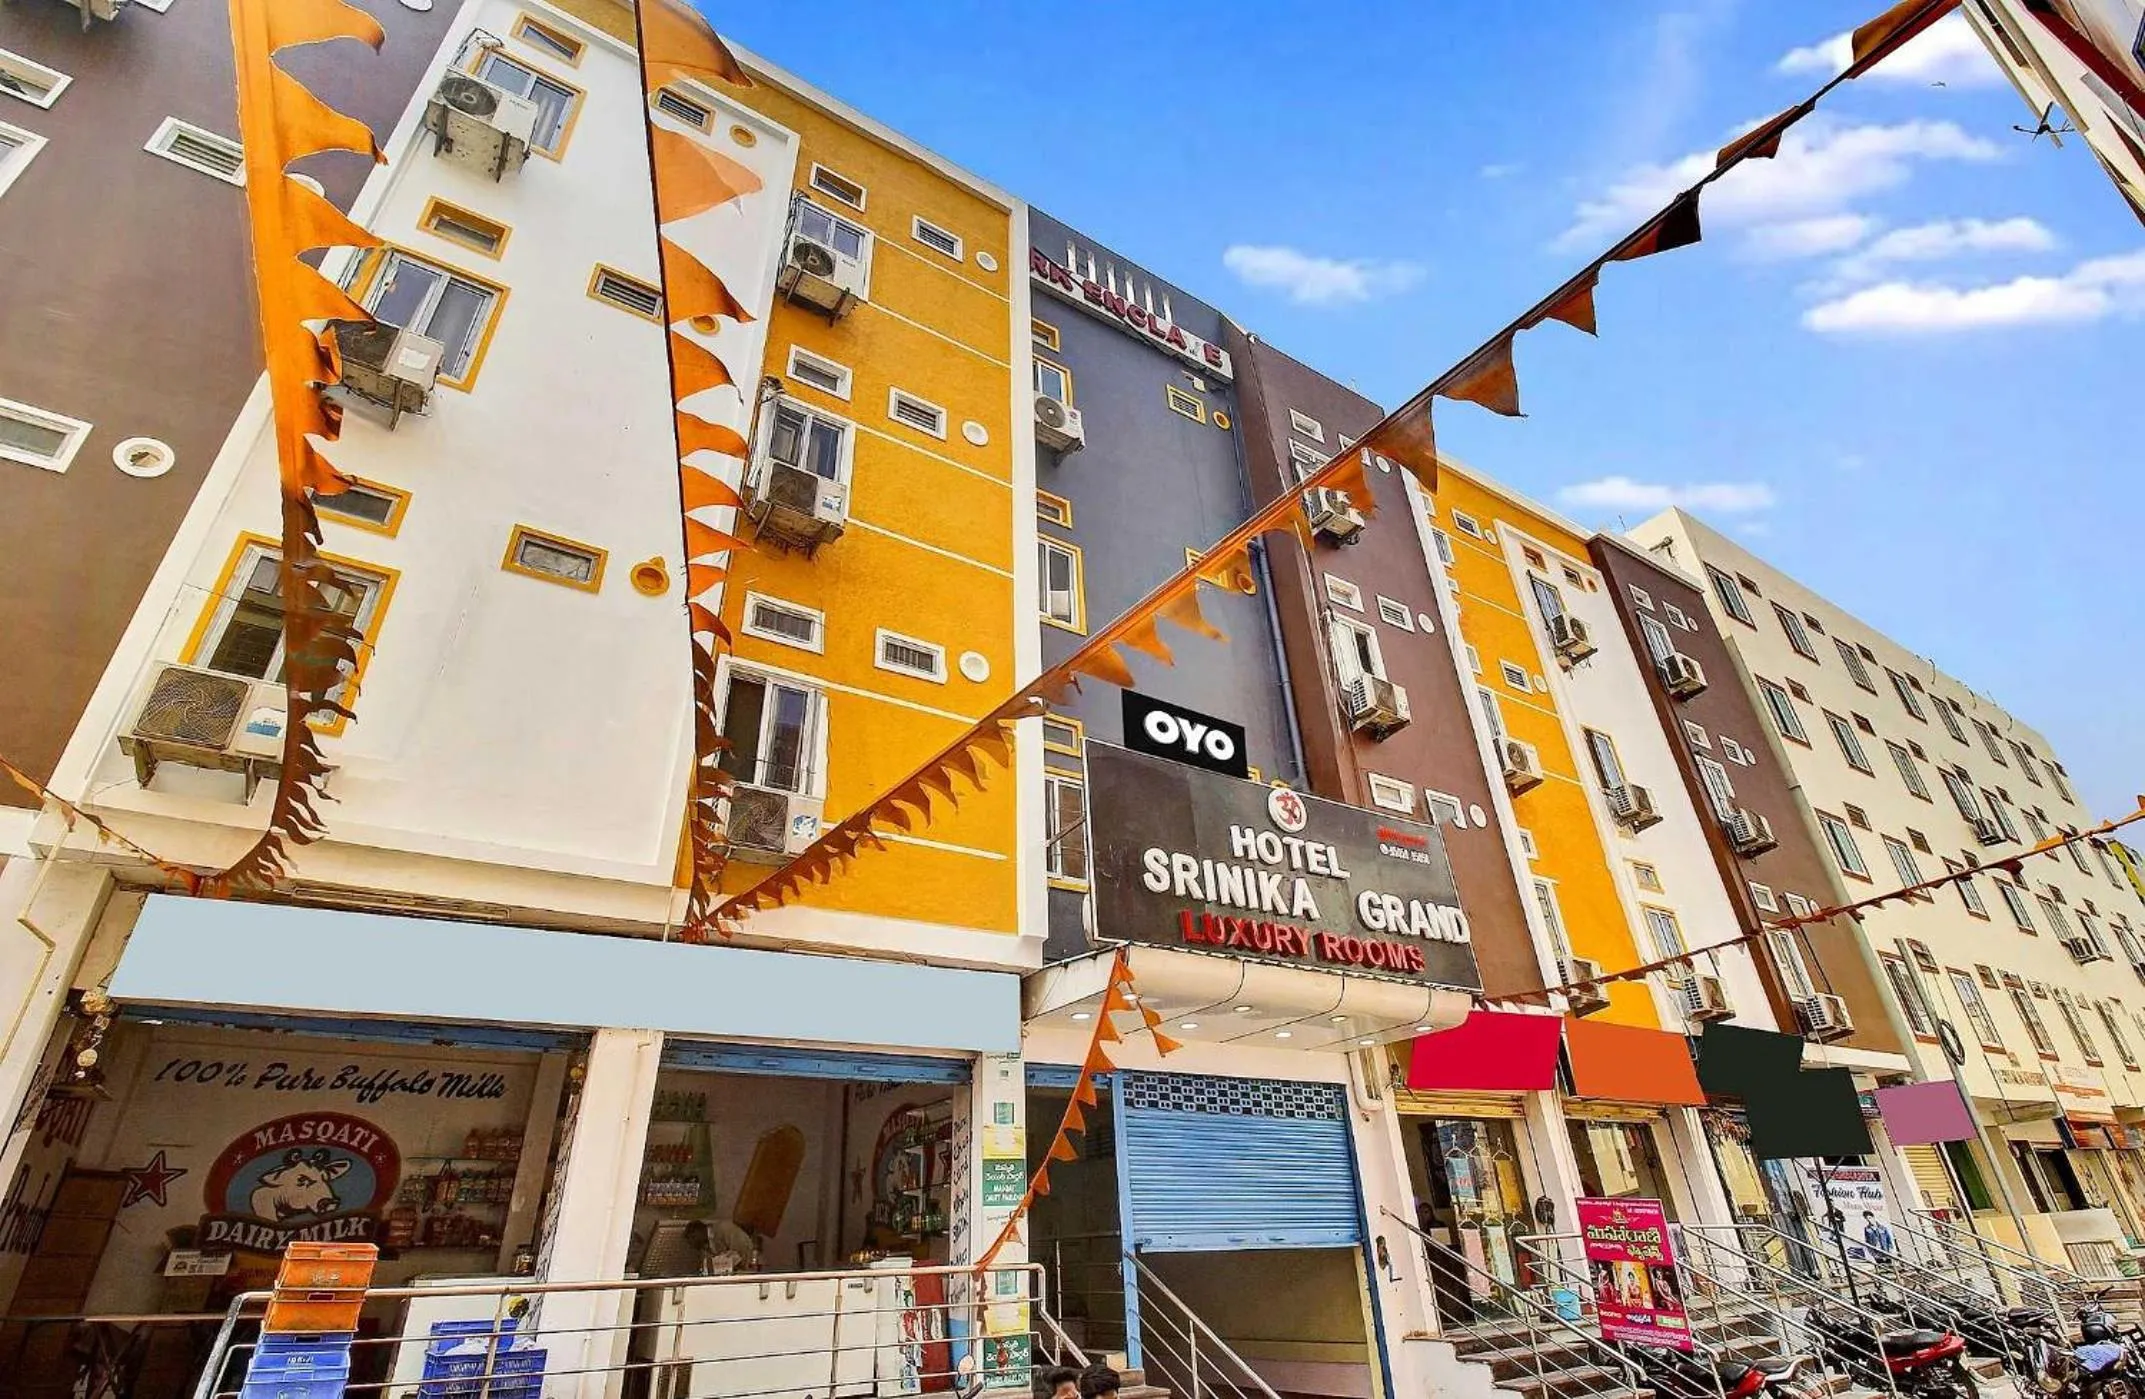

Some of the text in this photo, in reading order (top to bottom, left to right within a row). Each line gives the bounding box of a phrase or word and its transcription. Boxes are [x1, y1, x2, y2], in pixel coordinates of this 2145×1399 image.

[1083, 279, 1224, 368] ENCLAE
[1143, 710, 1235, 761] OYO
[1230, 825, 1350, 878] HOTEL
[1143, 847, 1471, 944] SRINIKA GRAND
[1180, 908, 1425, 973] LUXURY ROOMS
[154, 1058, 248, 1087] 100%
[253, 1062, 326, 1091] Pure
[329, 1064, 437, 1104] Buffalo
[254, 1120, 381, 1153] MASQATI
[1856, 1185, 1883, 1200] Hub
[207, 1216, 371, 1251] DAIRY MILK
